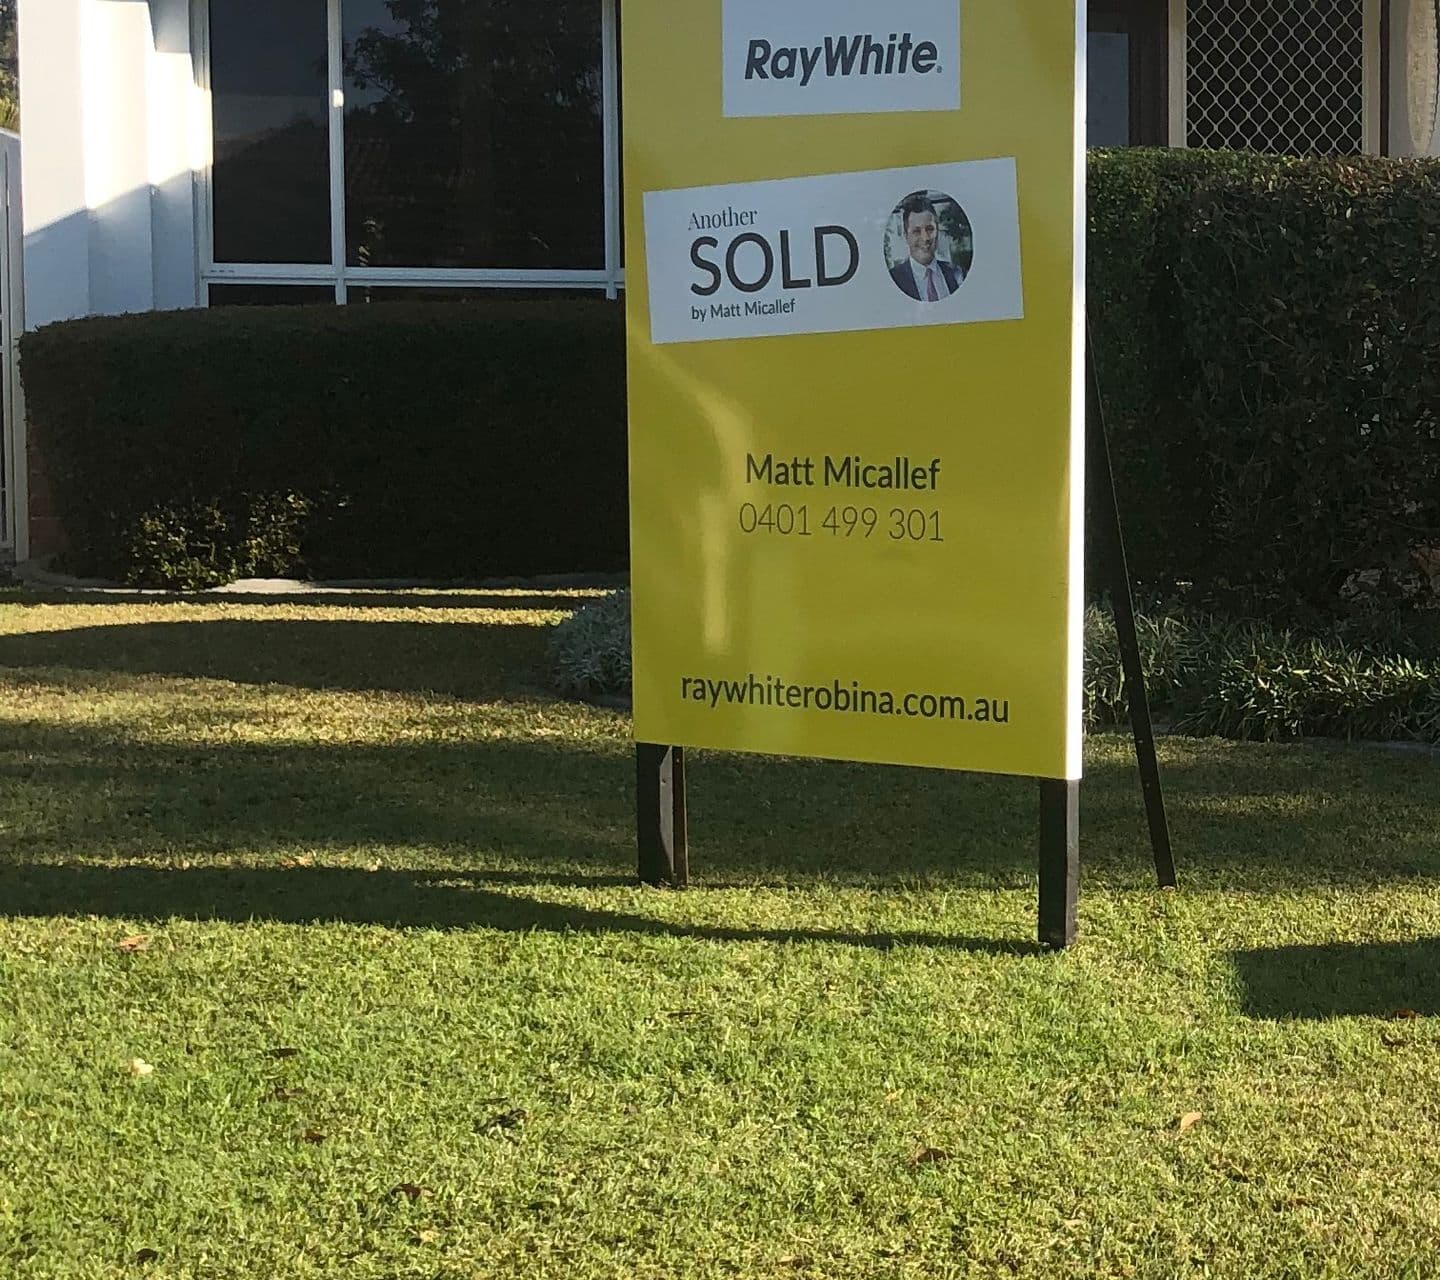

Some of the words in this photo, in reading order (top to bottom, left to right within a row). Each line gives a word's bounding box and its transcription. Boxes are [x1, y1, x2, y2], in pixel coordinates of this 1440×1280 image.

[688, 207, 758, 231] Another
[690, 225, 859, 296] SOLD
[691, 306, 706, 322] by
[710, 302, 741, 318] Matt
[744, 298, 796, 316] Micallef
[746, 453, 815, 486] Matt
[824, 455, 941, 490] Micallef
[739, 502, 812, 536] 0401
[822, 506, 878, 537] 499
[889, 508, 944, 542] 301
[681, 673, 1009, 723] raywhiterobina.com.au
